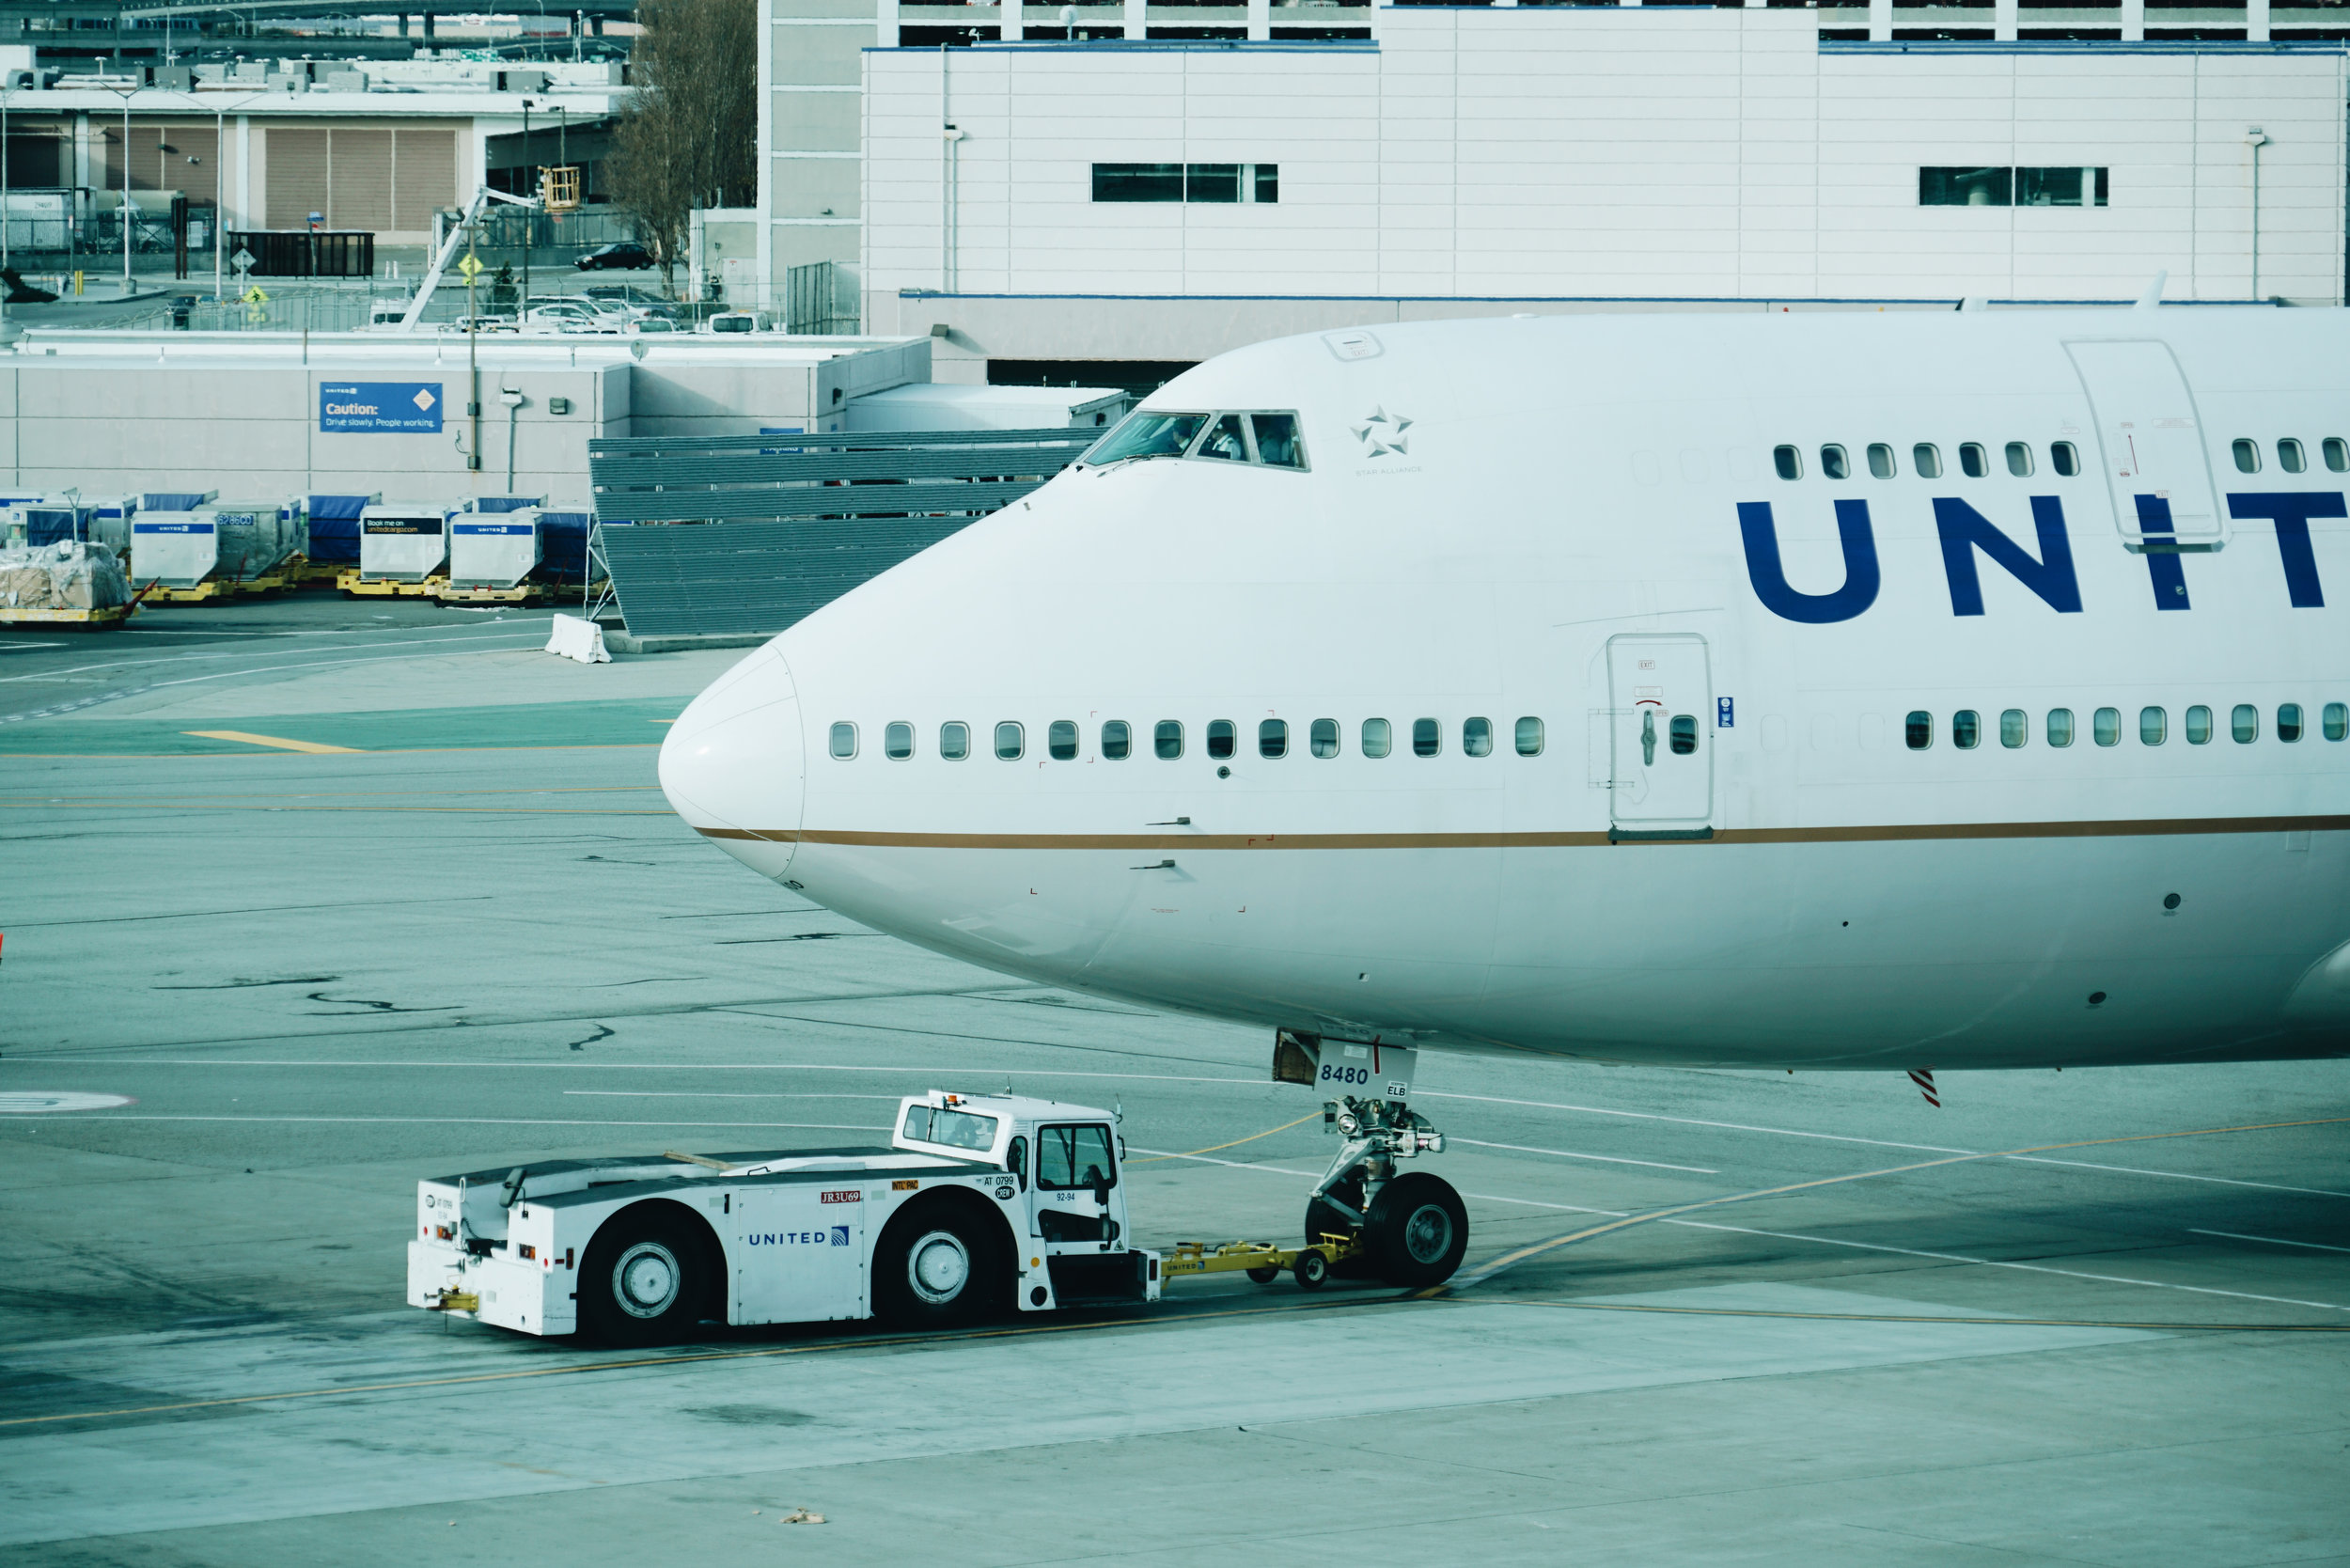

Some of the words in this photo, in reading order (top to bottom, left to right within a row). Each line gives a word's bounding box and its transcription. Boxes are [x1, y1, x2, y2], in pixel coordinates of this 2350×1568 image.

[325, 403, 379, 415] Caution:
[348, 418, 373, 427] slowly.
[376, 418, 401, 427] People
[403, 419, 435, 428] working.
[1381, 466, 1422, 475] ALLIANCE
[1736, 492, 2348, 624] UNIT
[1321, 1064, 1369, 1085] 8480
[1386, 1086, 1406, 1096] ELB
[984, 1177, 993, 1185] AT
[996, 1176, 1014, 1185] 0799
[822, 1191, 860, 1203] JR3U69
[1057, 1193, 1075, 1201] 92-94
[748, 1232, 825, 1246] UNITED
